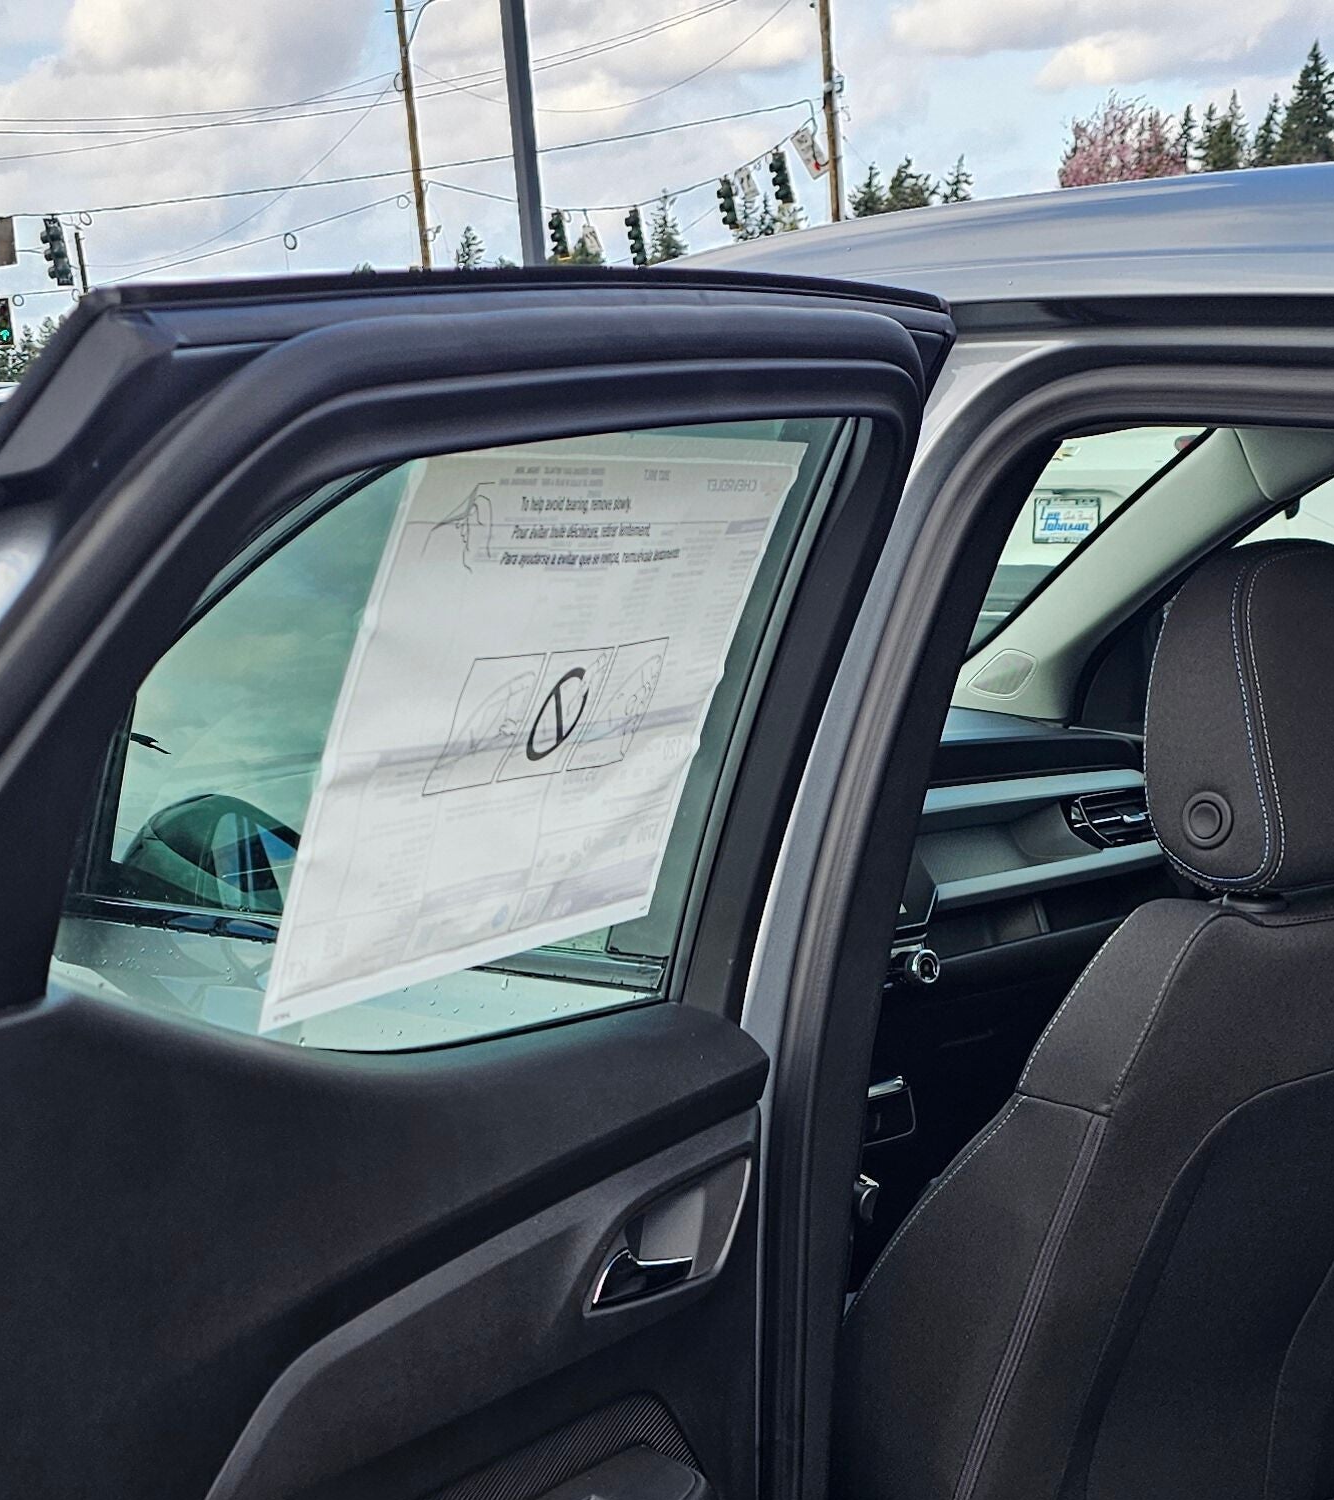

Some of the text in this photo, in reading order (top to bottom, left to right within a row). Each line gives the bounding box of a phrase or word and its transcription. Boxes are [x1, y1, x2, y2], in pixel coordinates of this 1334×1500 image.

[521, 496, 530, 511] To
[530, 496, 544, 514] help
[545, 496, 566, 511] avoid
[591, 499, 613, 511] remove
[1040, 506, 1060, 520] Lee
[511, 524, 529, 539] Pour
[1040, 519, 1089, 531] Johnson
[500, 552, 519, 565] Para
[557, 552, 579, 565] evitar
[578, 554, 591, 568] que
[591, 554, 601, 565] se
